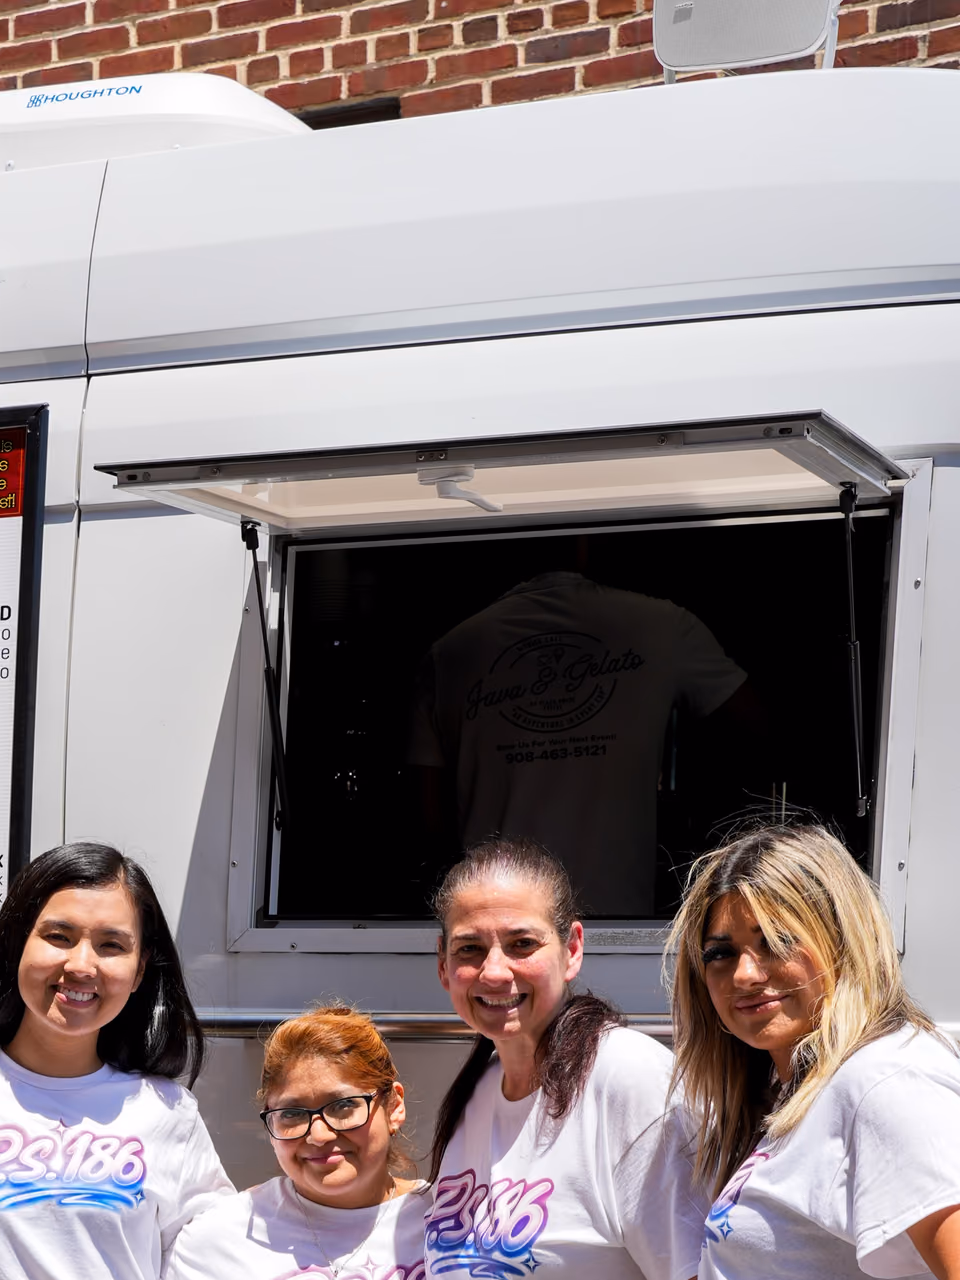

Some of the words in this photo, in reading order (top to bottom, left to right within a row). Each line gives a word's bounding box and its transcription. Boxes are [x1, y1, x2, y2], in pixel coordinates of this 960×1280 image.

[44, 86, 142, 103] HOUGHTON
[1, 440, 13, 453] is
[466, 678, 527, 721] Java
[530, 665, 558, 695] &
[562, 648, 645, 692] Gelato
[532, 740, 546, 748] For
[548, 738, 567, 746] Your
[505, 744, 607, 764] 908-463-5121
